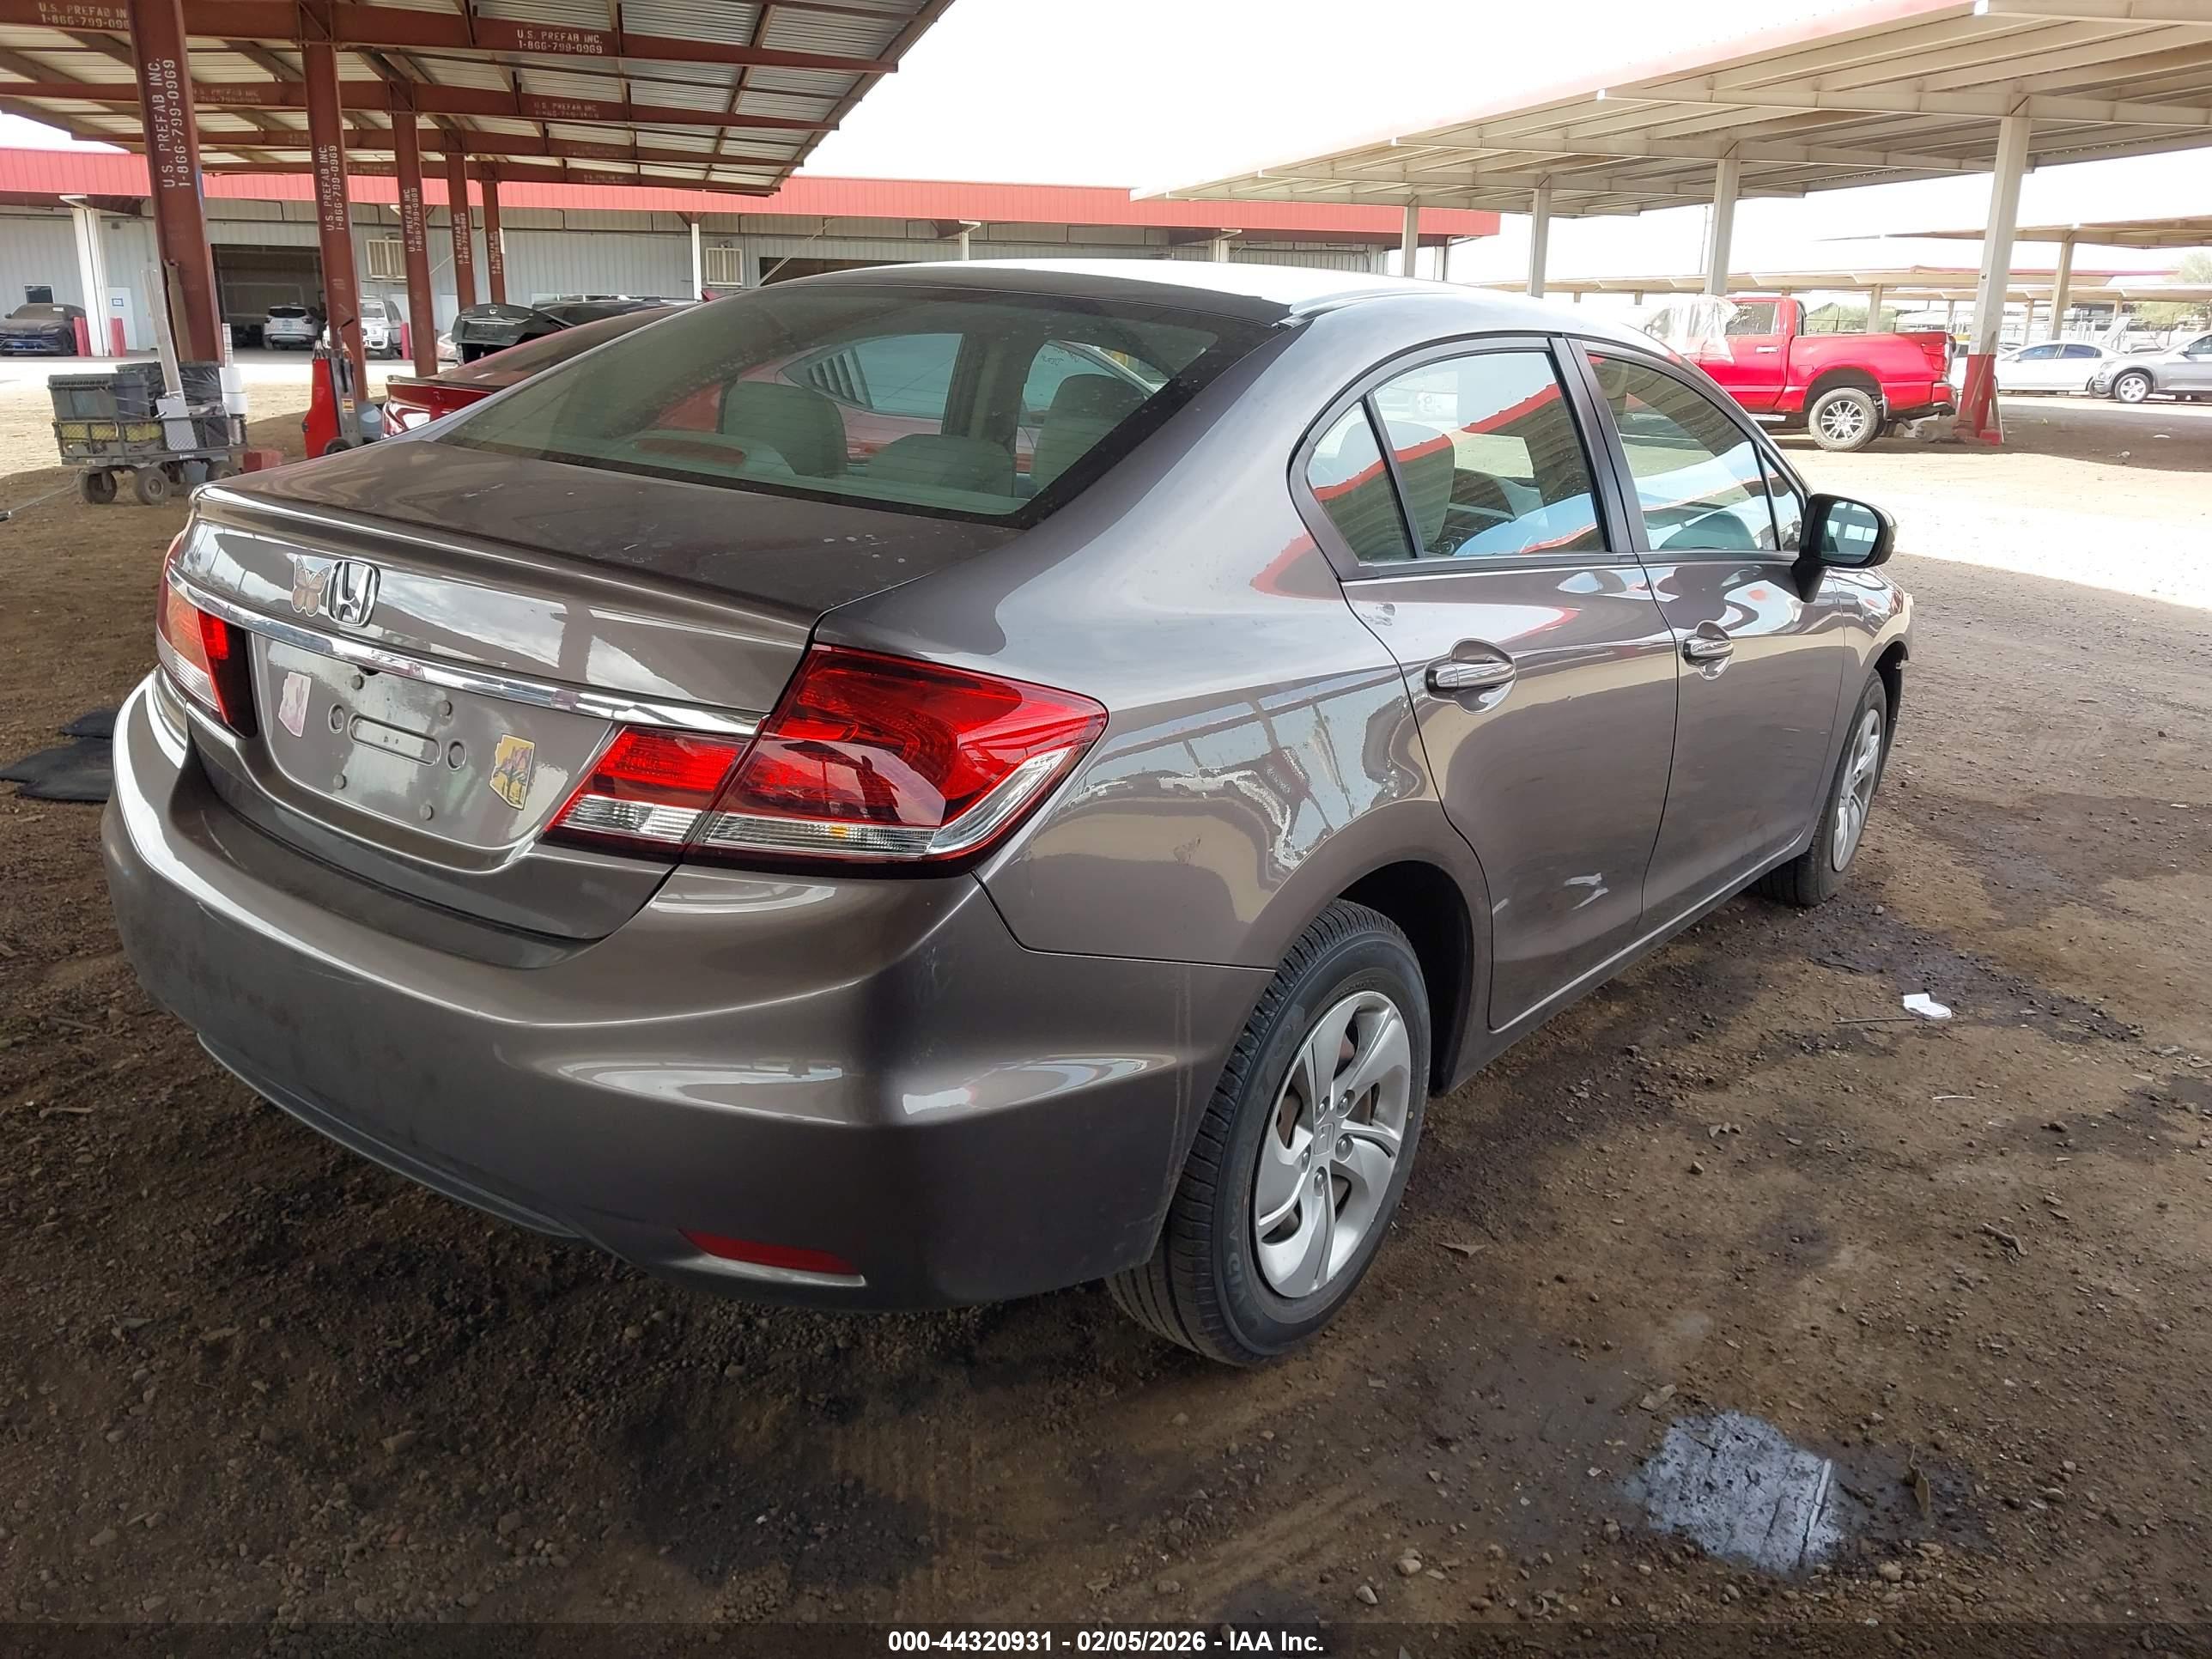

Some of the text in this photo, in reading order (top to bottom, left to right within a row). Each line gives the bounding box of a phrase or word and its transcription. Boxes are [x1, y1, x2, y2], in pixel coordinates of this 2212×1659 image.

[41, 14, 130, 29] 1-866-799-096
[67, 4, 111, 17] PREFAB
[115, 7, 127, 19] IN
[517, 28, 603, 44] U.S. PREFAB INC.
[519, 40, 603, 54] 1-866-799-0969
[148, 58, 176, 188] U.S. PREFAB INC.
[162, 59, 191, 187] 1-866-799-0969
[319, 144, 335, 231] U.S. PREFAB INC.
[329, 145, 345, 230] 1-866-799-0969
